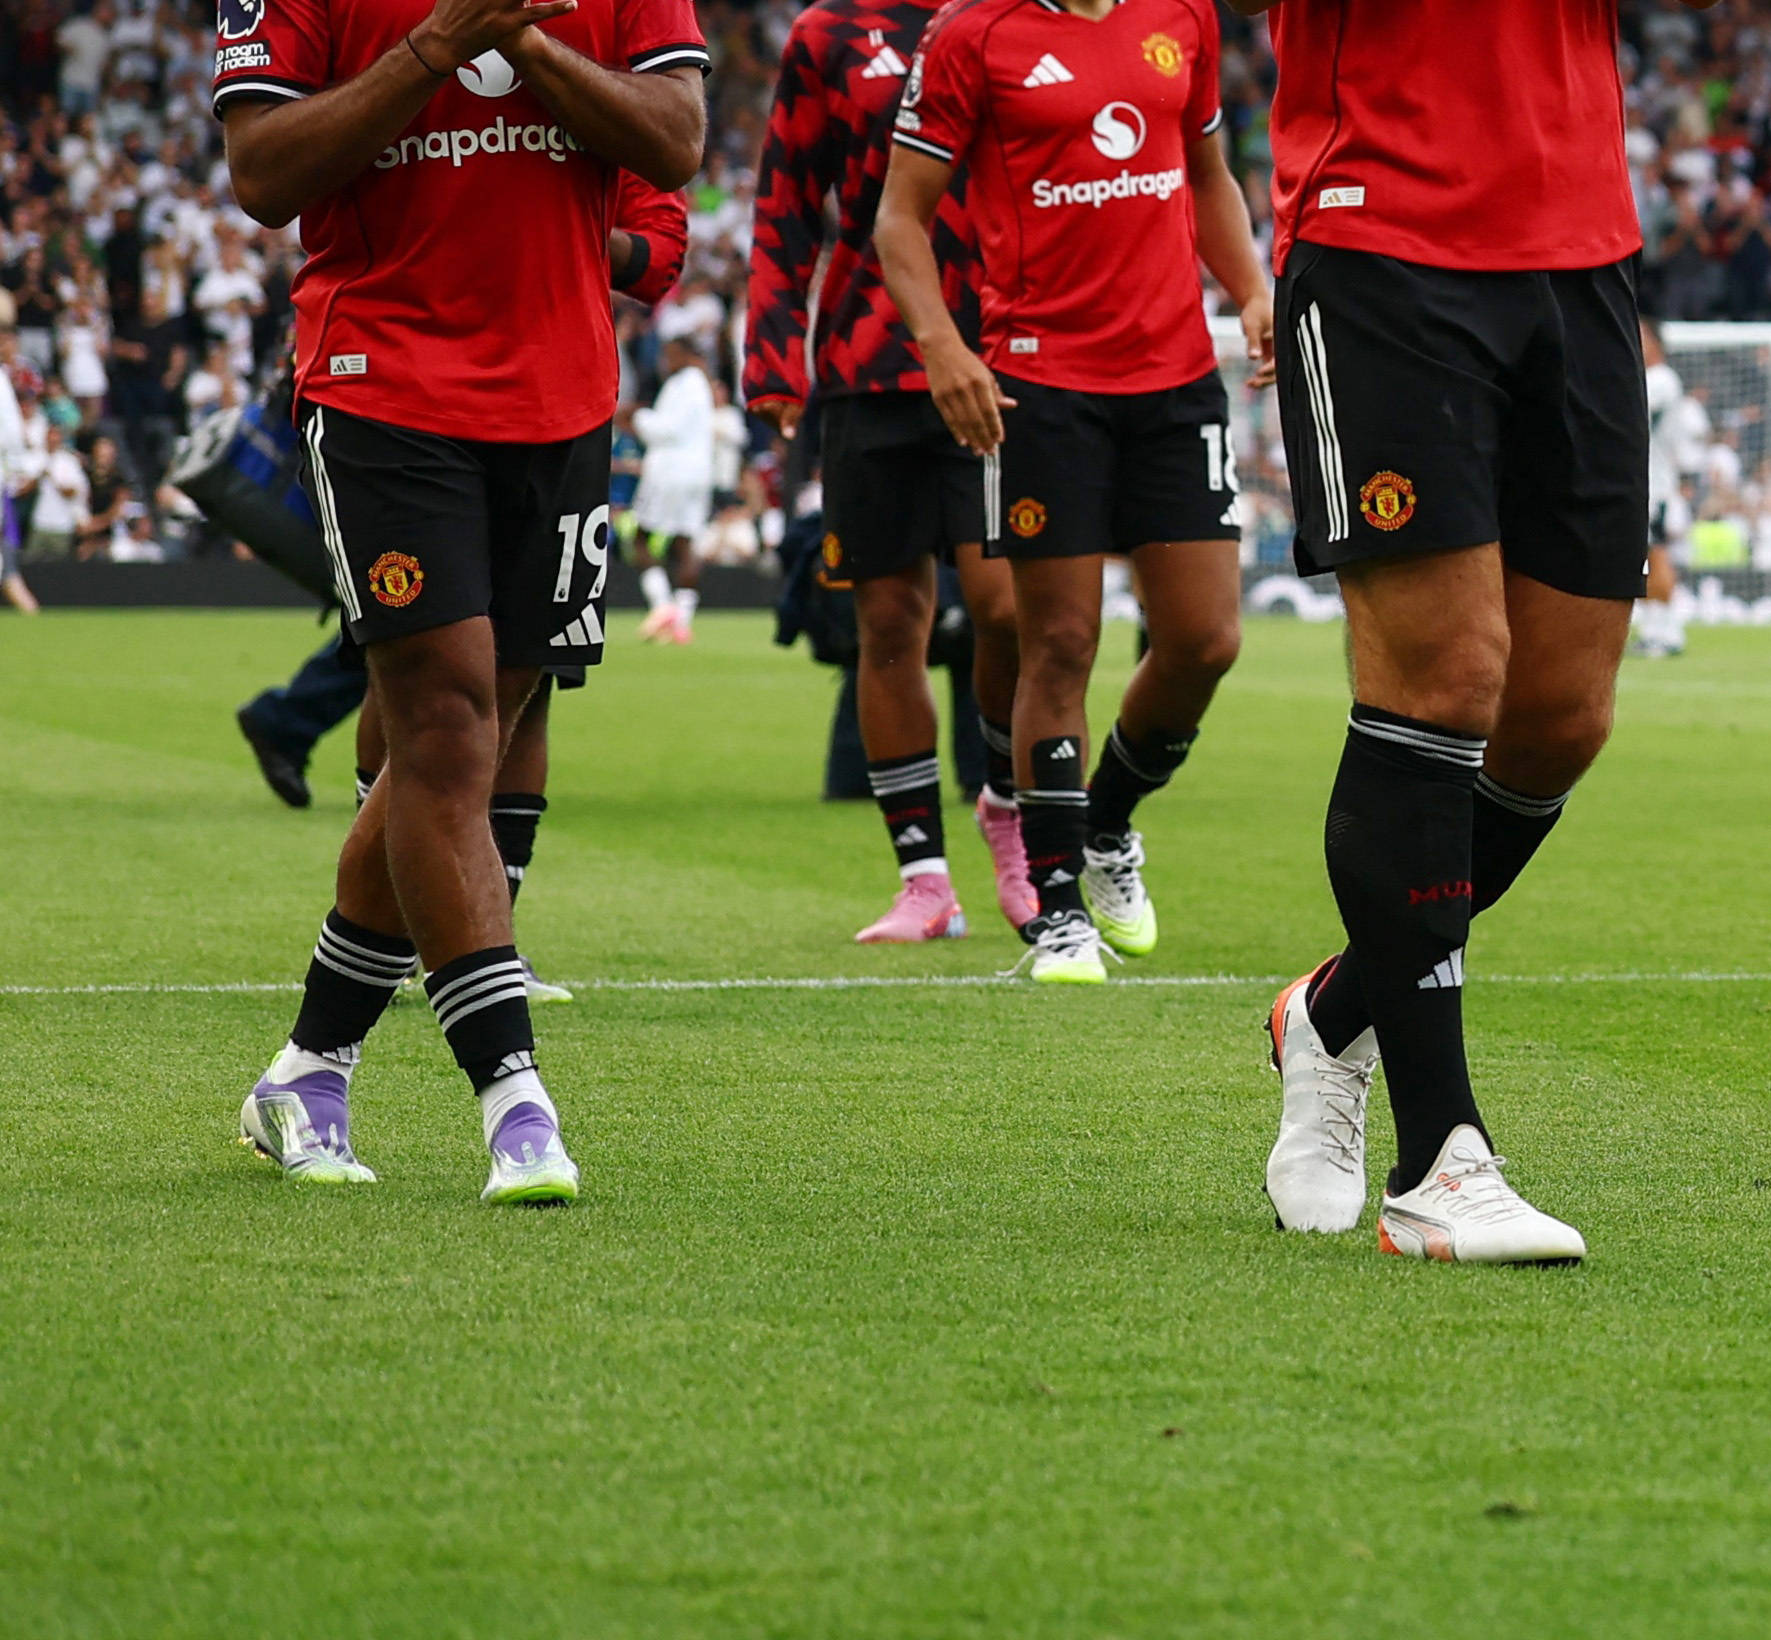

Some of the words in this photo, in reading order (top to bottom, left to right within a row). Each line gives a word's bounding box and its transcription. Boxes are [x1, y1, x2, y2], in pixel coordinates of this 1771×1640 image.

[226, 43, 264, 58] room
[1032, 168, 1183, 209] Snapdragon
[553, 504, 609, 603] 19
